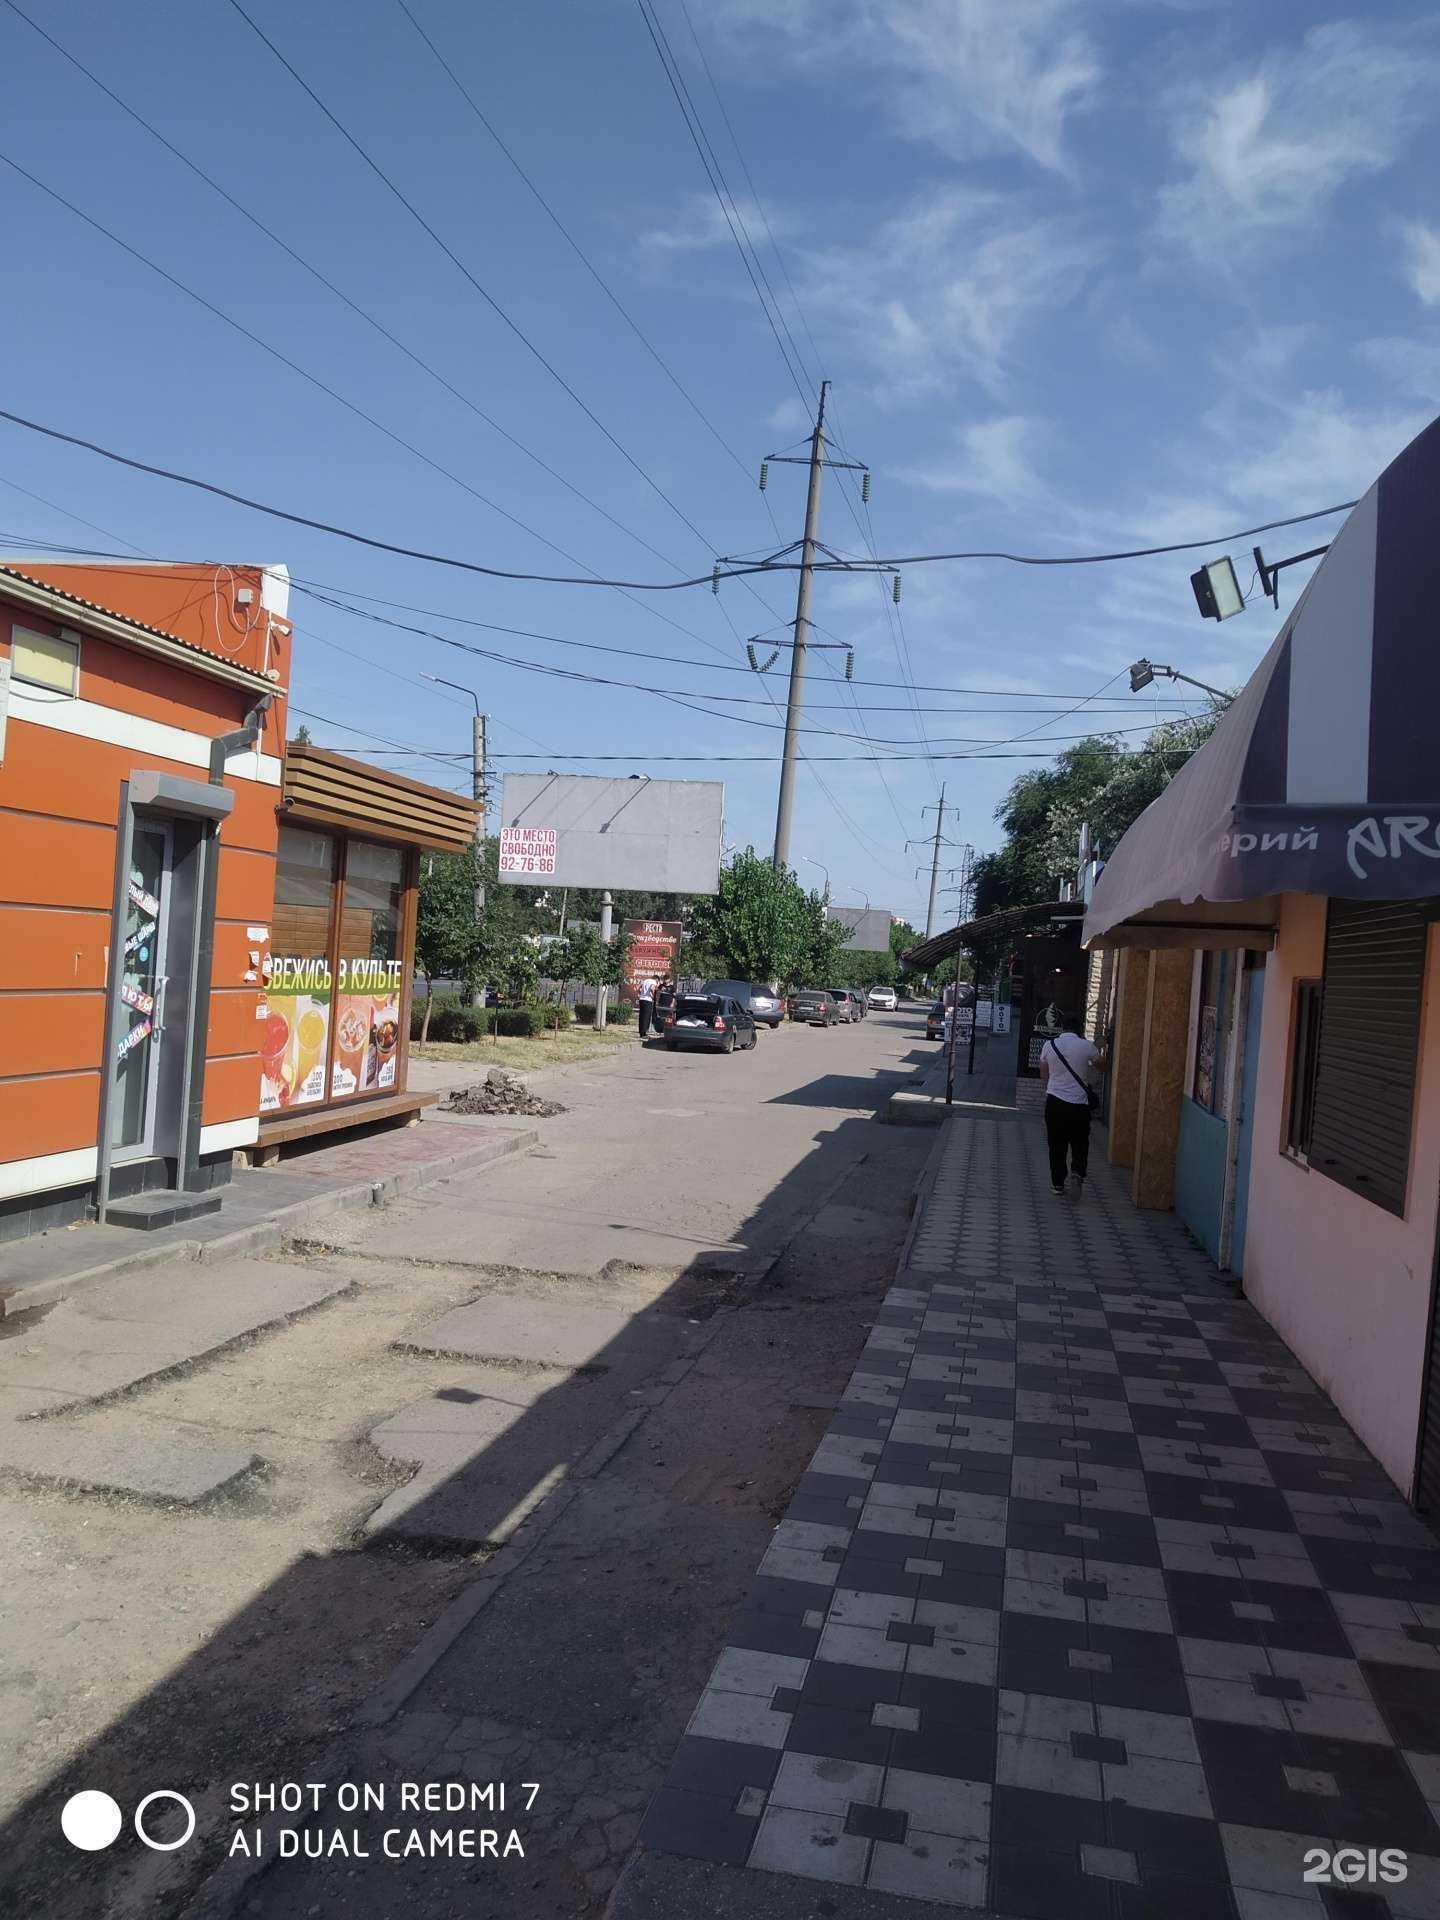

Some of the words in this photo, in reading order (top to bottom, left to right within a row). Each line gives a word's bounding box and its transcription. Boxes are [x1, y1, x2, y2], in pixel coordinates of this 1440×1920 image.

[502, 828, 520, 841] ЭТО
[523, 829, 555, 843] МЕСТО
[501, 842, 555, 857] СВОБОДНО
[1346, 816, 1440, 880] AR
[500, 856, 554, 873] 92-76-86
[350, 958, 402, 991] КУЛЬТЕ
